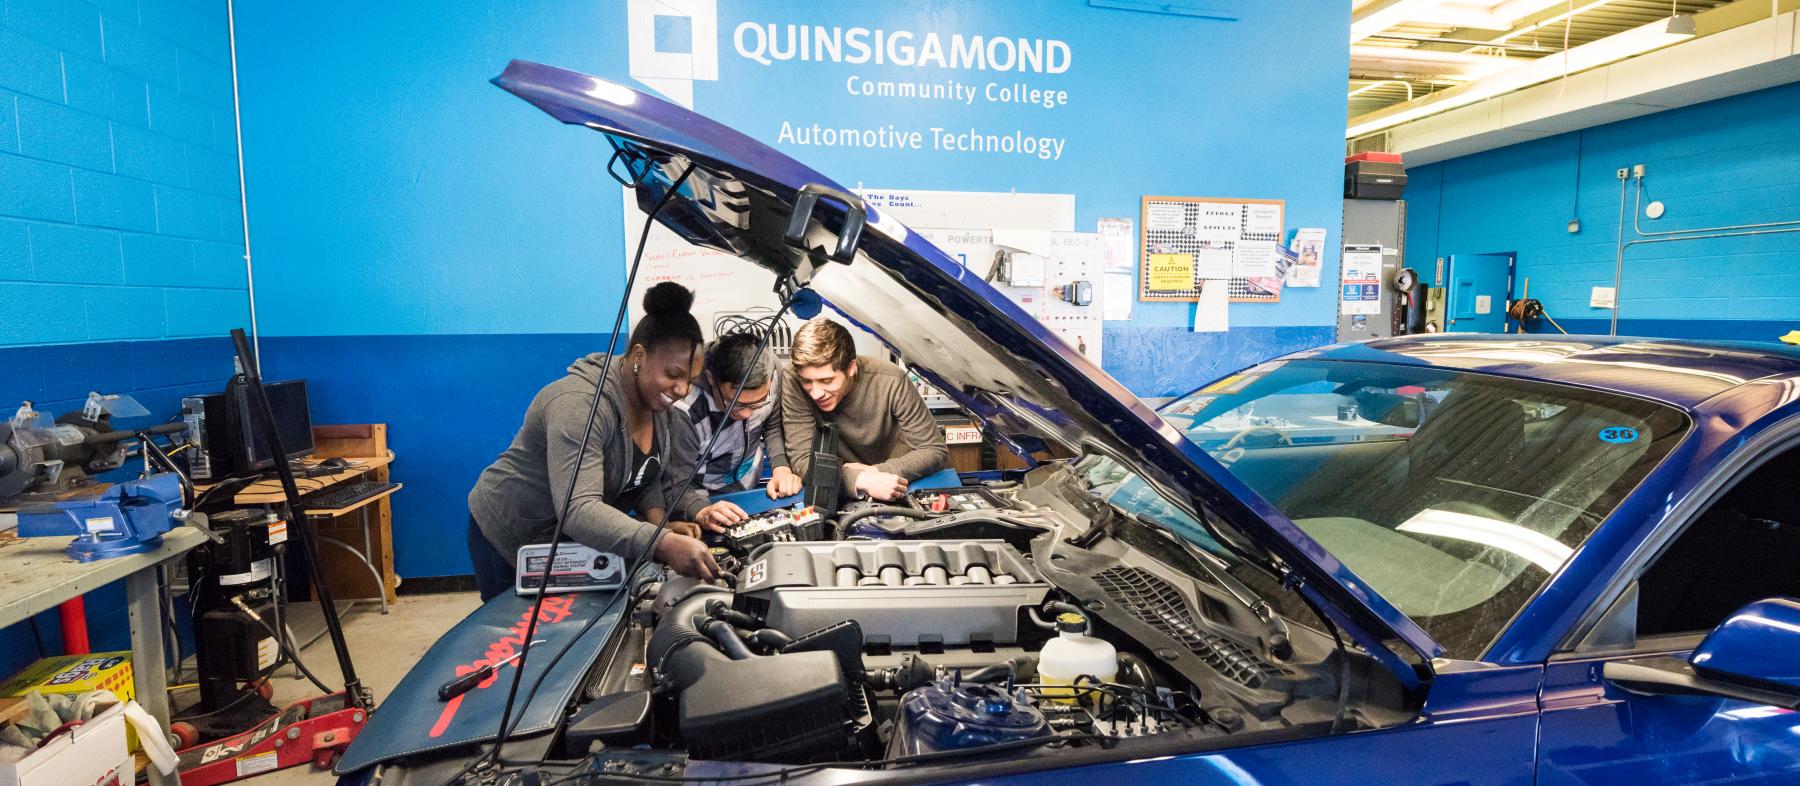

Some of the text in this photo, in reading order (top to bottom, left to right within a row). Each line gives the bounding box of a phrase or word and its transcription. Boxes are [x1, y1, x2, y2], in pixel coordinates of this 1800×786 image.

[733, 21, 1072, 74] QUINSIGAMOND
[847, 75, 1068, 109] Community College
[777, 120, 1065, 161] Automotive Technology
[889, 194, 909, 202] Days
